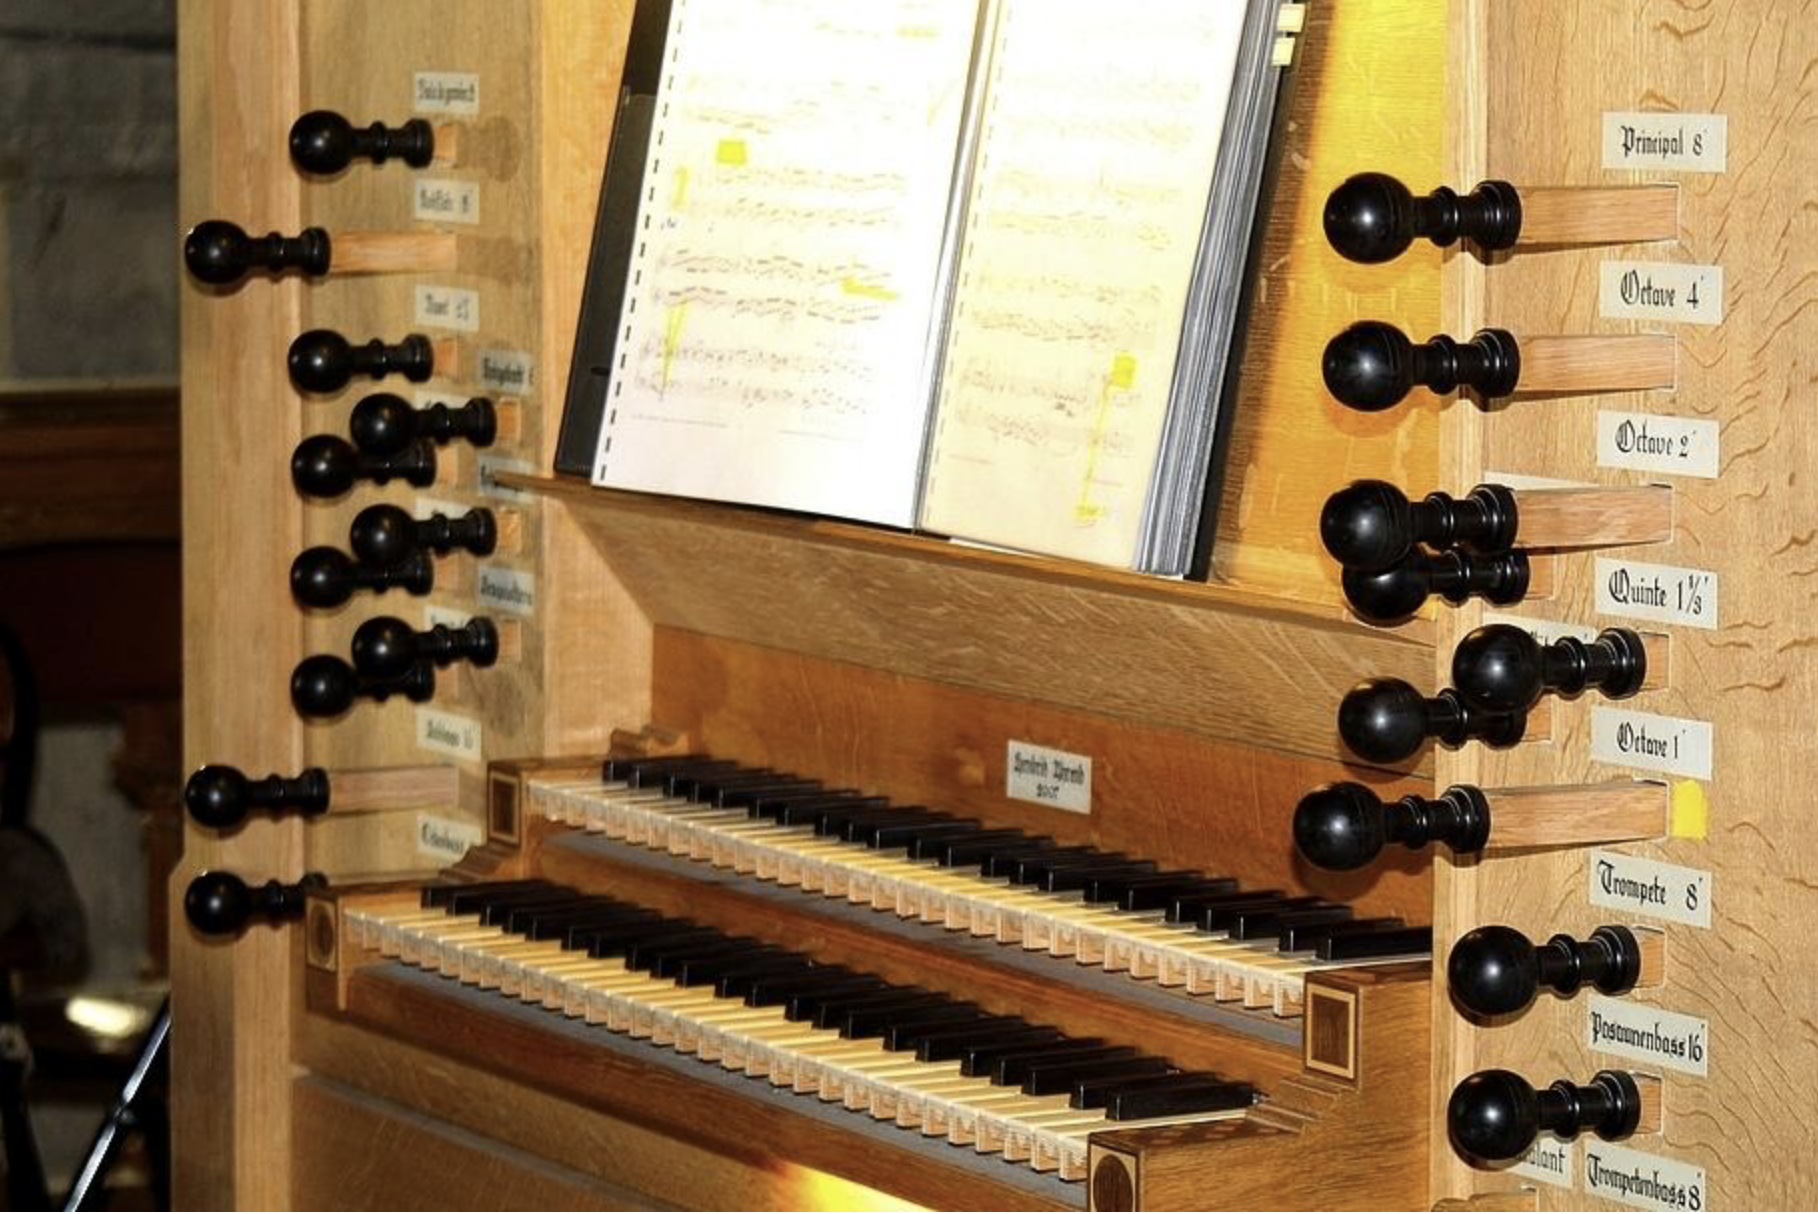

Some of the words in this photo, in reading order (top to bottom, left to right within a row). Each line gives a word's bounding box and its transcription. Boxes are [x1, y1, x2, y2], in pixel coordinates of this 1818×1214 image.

[1620, 125, 1684, 161] Principal
[1620, 268, 1676, 308] Octave
[1615, 419, 1674, 457] Octave
[1608, 567, 1668, 609] Quinte
[1616, 721, 1668, 758] Octave
[1597, 858, 1667, 907] Trompete
[1590, 1011, 1686, 1058] Posaunenbass
[1586, 1153, 1687, 1209] Trompetenbass
